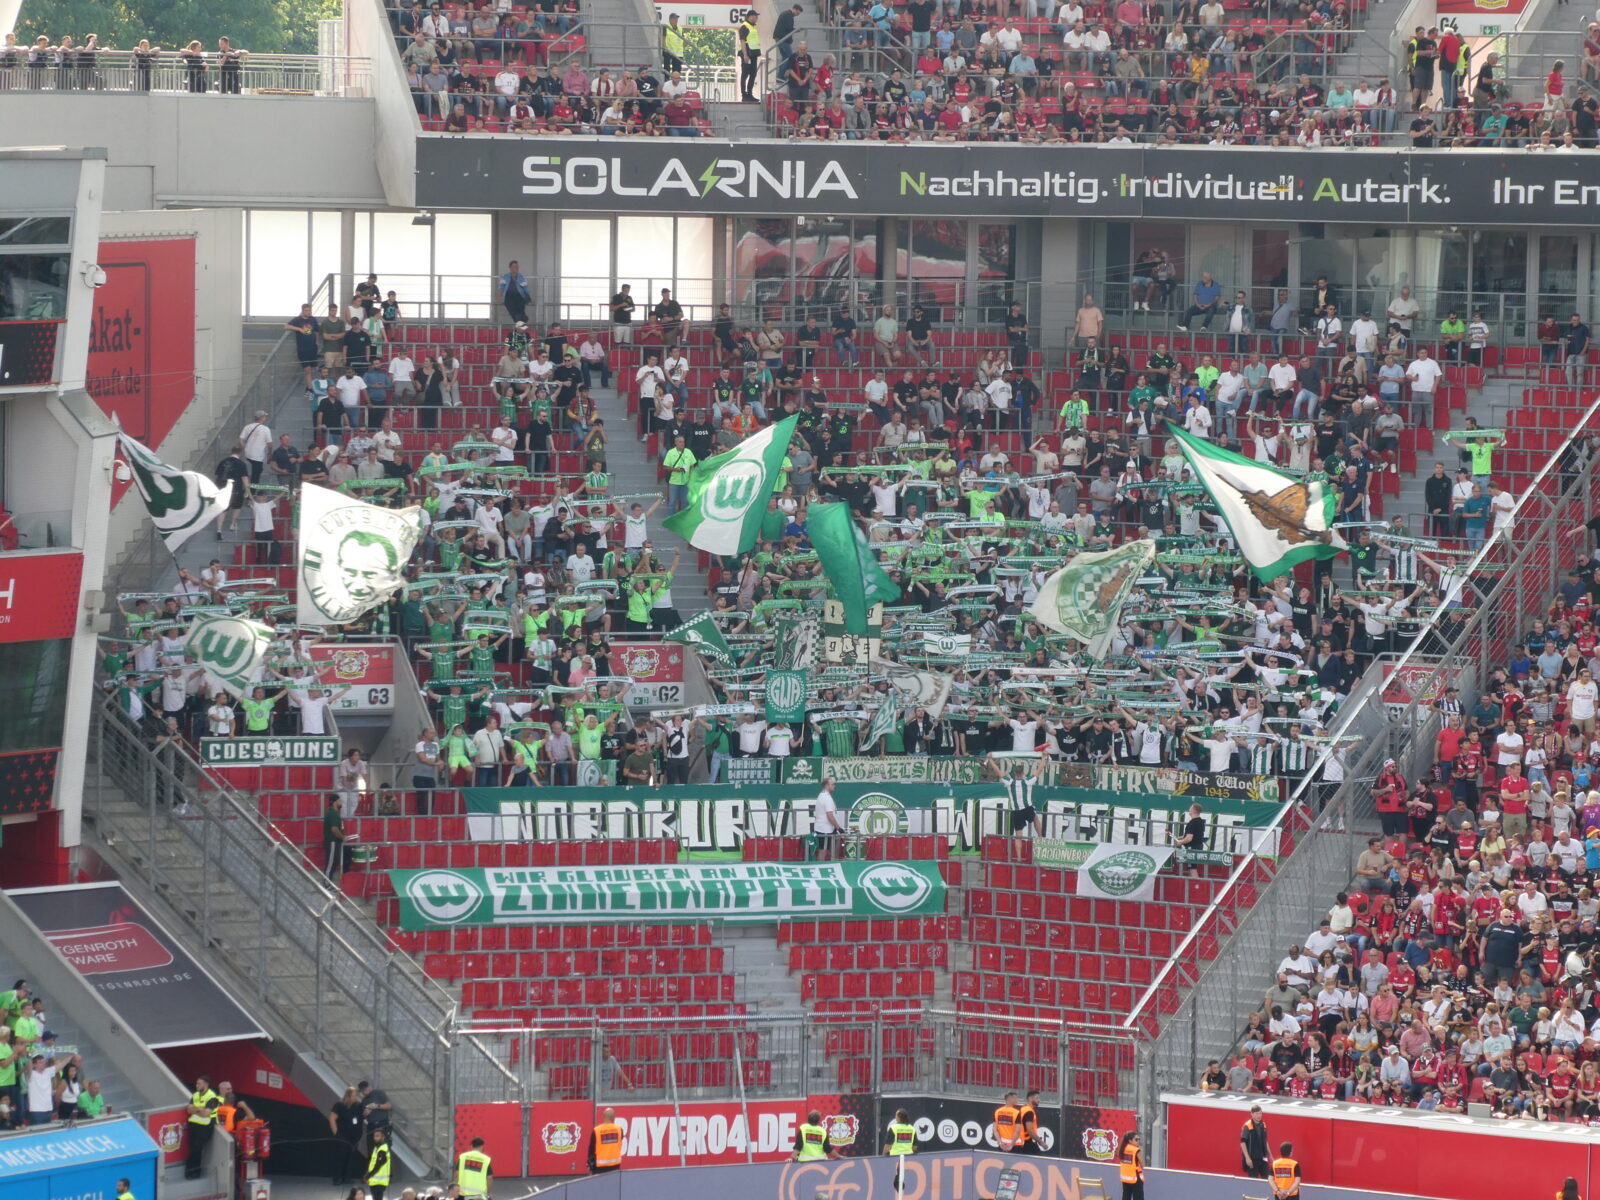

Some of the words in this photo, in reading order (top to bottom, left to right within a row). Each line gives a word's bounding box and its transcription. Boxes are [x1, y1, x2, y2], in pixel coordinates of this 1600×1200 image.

[522, 156, 859, 199] SOLARNIA
[900, 170, 1108, 204] Nachhaltig.
[1120, 172, 1304, 202] Individuell.
[1312, 176, 1452, 204] Autark.
[1493, 177, 1544, 204] Ihr
[368, 688, 389, 704] G3
[659, 686, 680, 701] G2
[1205, 787, 1230, 798] 1945
[493, 870, 547, 883] WIR
[557, 868, 691, 883] GLAUBEN
[701, 866, 736, 879] AN
[747, 866, 836, 879] UNSER
[613, 1112, 797, 1158] BAYER04.DE
